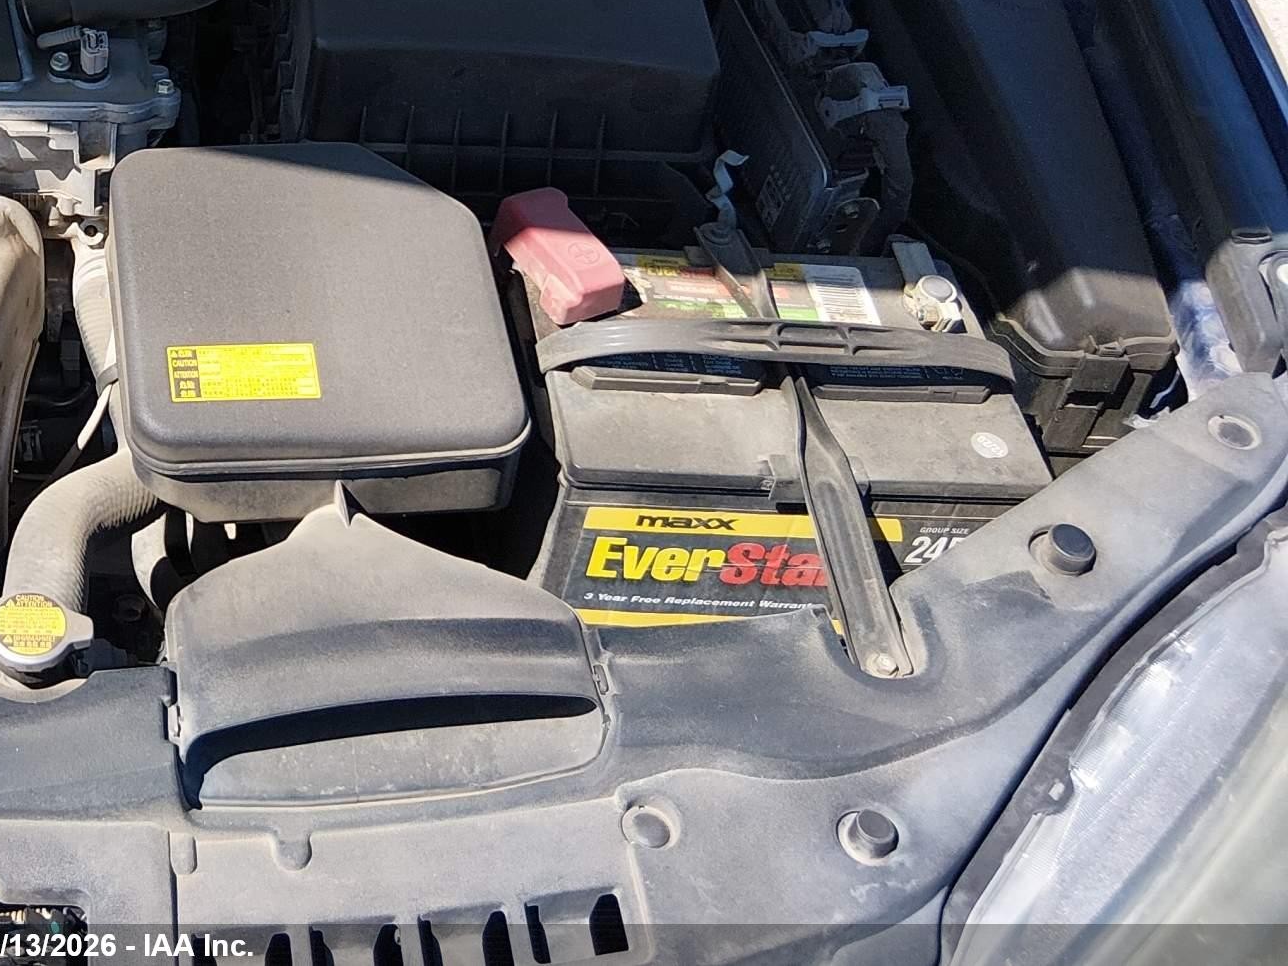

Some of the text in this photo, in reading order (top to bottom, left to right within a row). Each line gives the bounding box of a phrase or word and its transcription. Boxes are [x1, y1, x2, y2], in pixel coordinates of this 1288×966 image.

[635, 514, 739, 531] maxx
[583, 592, 813, 610] 3 Year Free Replacement Warrant
